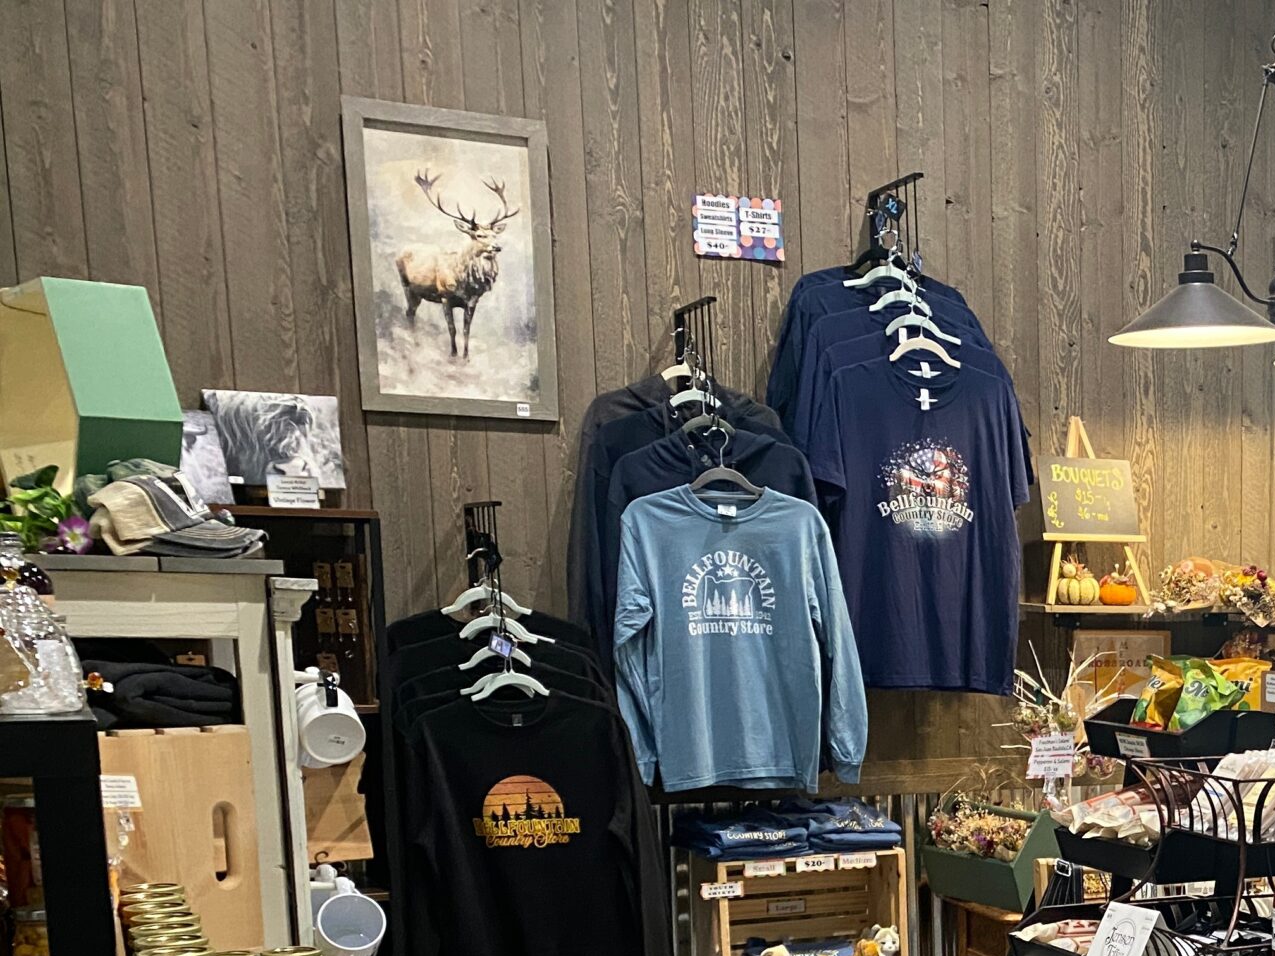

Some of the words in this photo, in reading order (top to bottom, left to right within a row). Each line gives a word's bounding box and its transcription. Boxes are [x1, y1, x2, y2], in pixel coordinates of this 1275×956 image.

[701, 198, 730, 209] Hoodies
[745, 210, 772, 220] T-Shirts
[1051, 463, 1124, 490] BOUQUETS
[877, 492, 974, 522] Bellfountain
[682, 550, 776, 609] BELLFOUNTAIN
[688, 621, 739, 636] Country
[741, 620, 773, 635] Store
[473, 818, 580, 836] BELLFOUNTAIN
